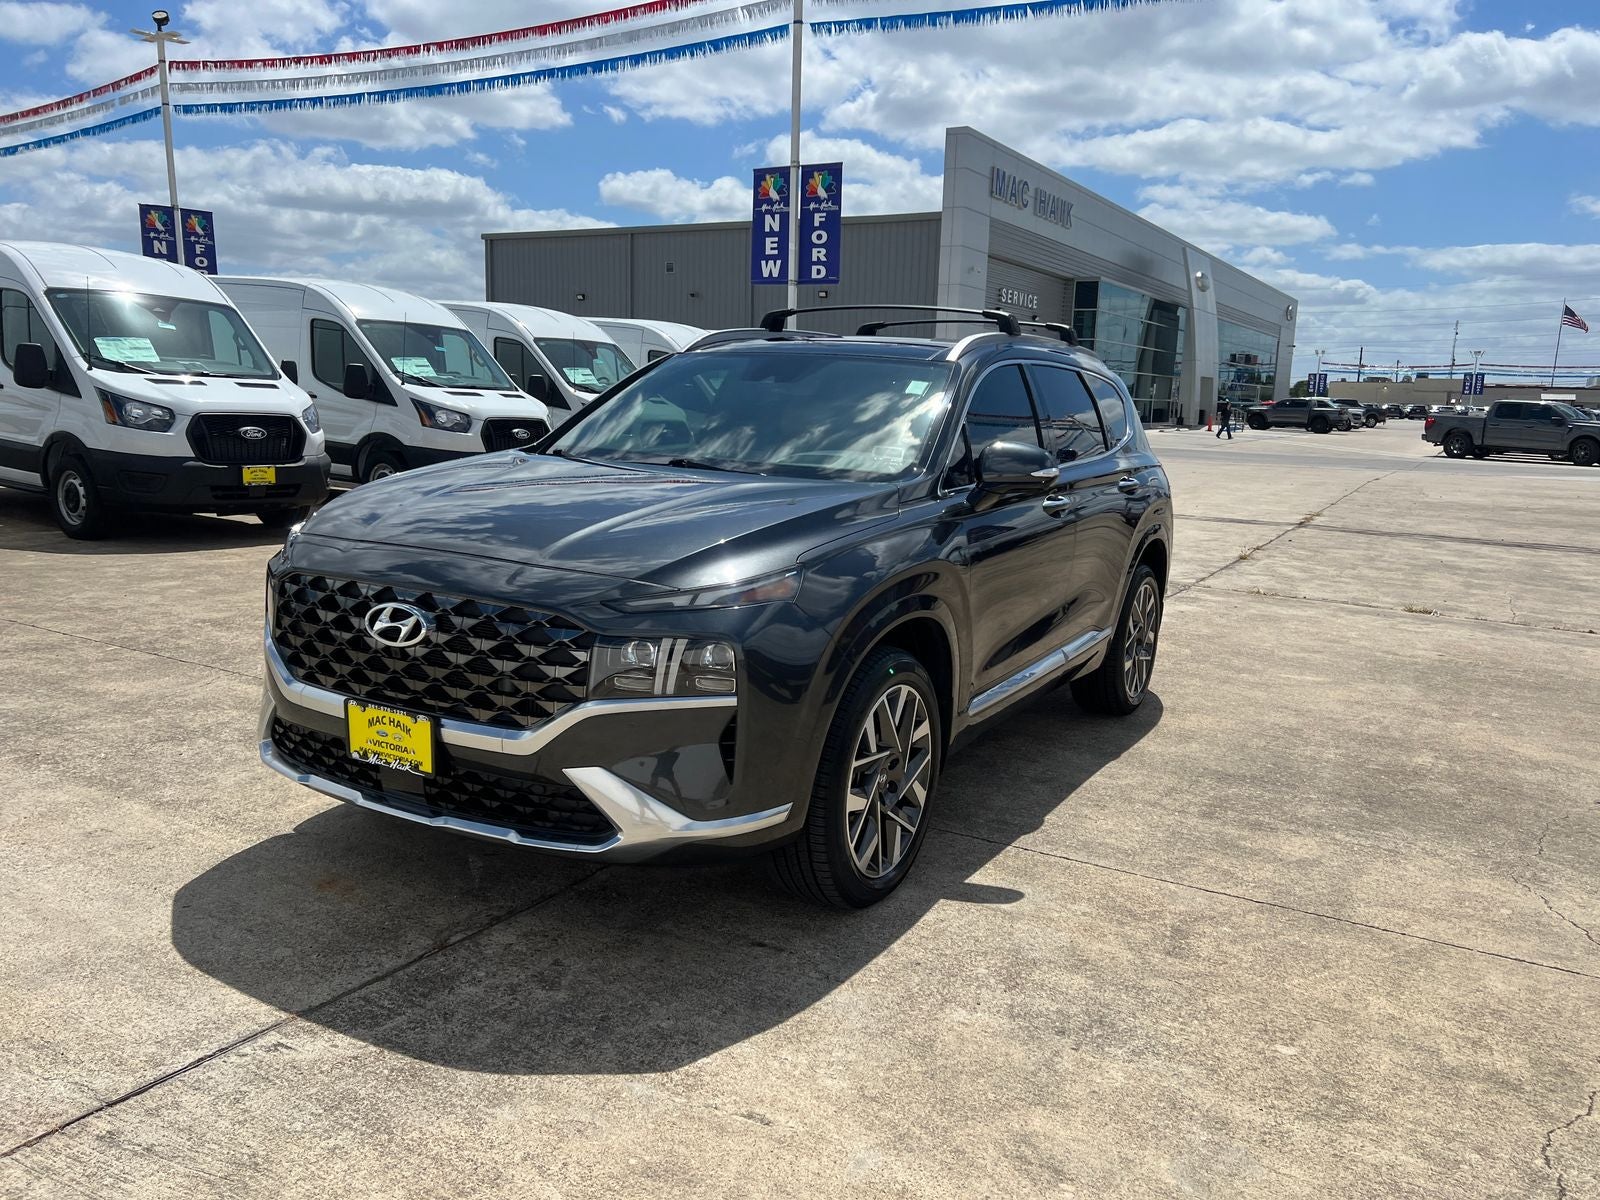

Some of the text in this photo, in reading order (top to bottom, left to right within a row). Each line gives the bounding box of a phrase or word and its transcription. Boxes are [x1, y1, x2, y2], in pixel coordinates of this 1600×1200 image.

[992, 167, 1073, 228] MAC HAIK
[761, 214, 781, 278] NEW
[811, 213, 828, 279] FORD
[1001, 288, 1038, 309] SERVICE
[246, 430, 263, 438] Ford
[368, 715, 387, 728] MAC
[388, 717, 412, 738] HAIK
[372, 739, 410, 755] VICTORIA
[367, 754, 412, 772] Mac Haik
